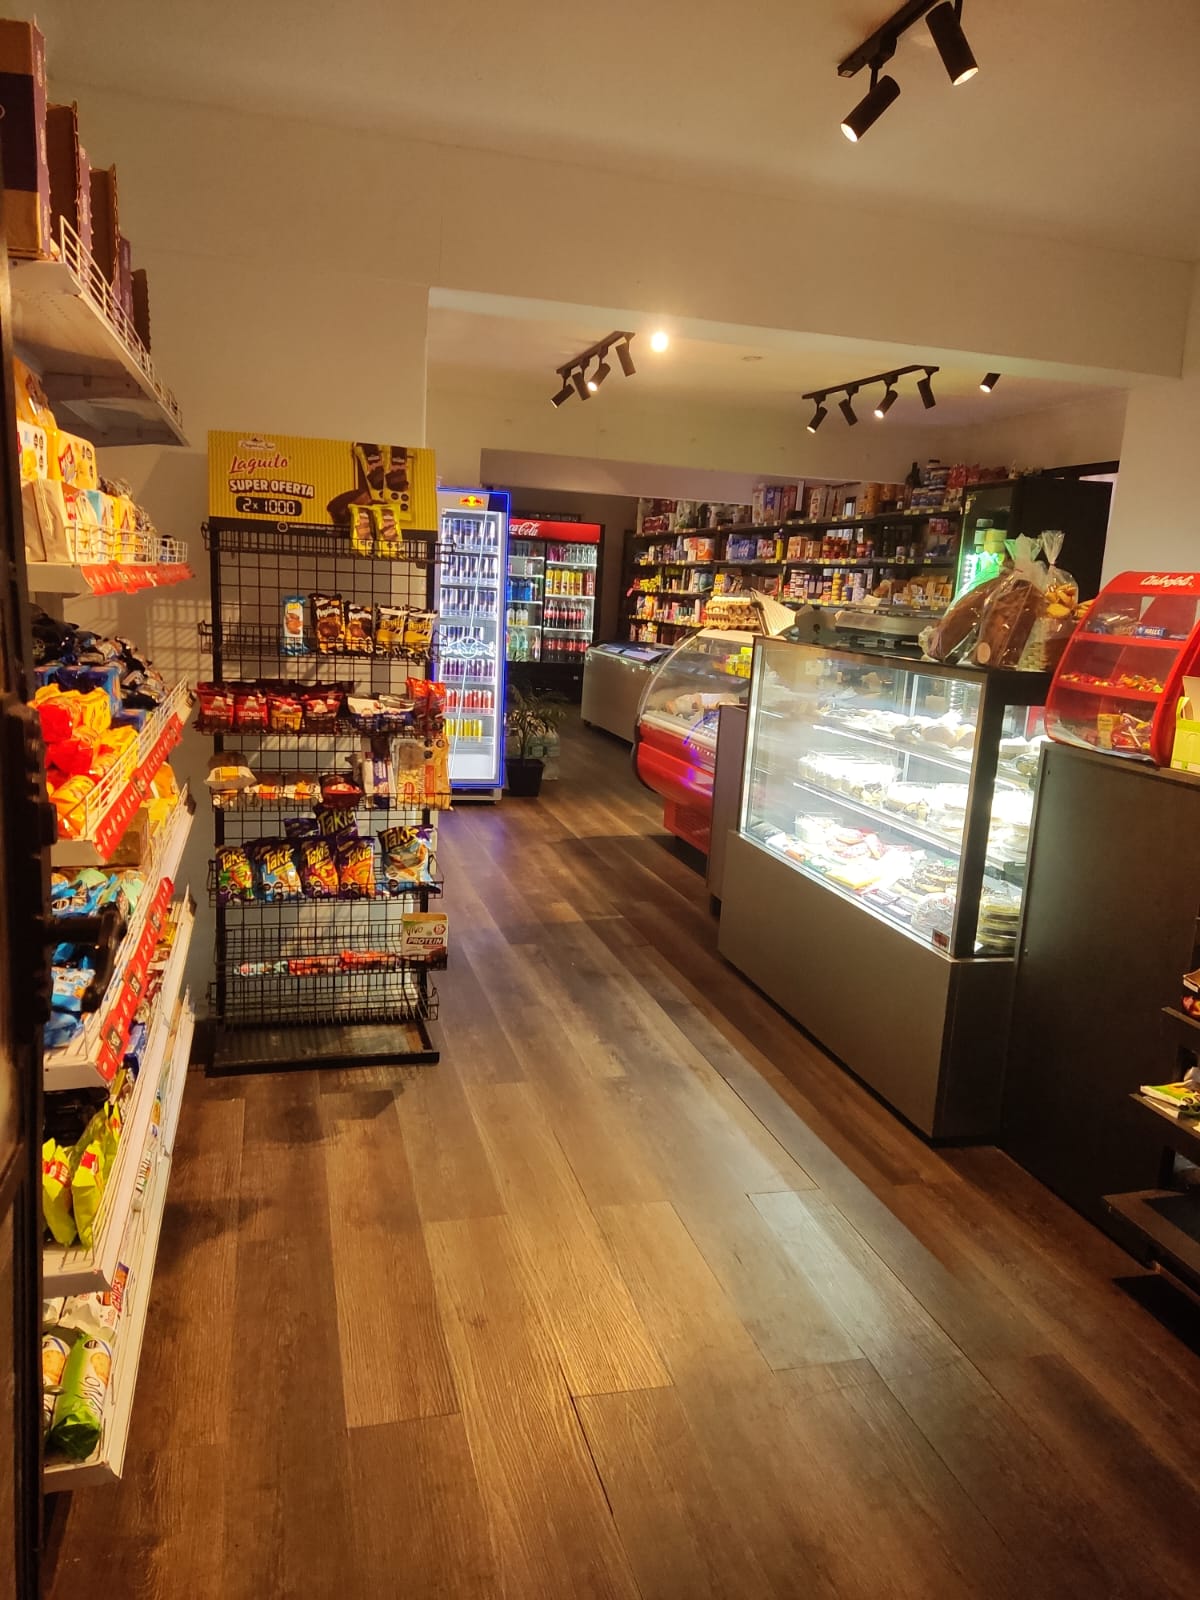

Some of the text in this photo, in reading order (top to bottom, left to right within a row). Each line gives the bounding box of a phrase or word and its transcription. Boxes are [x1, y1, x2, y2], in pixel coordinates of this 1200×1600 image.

[229, 479, 315, 499] SUPER OFERTA
[264, 500, 296, 515] 1000
[318, 809, 357, 835] Takis
[407, 937, 443, 945] PROTEIN
